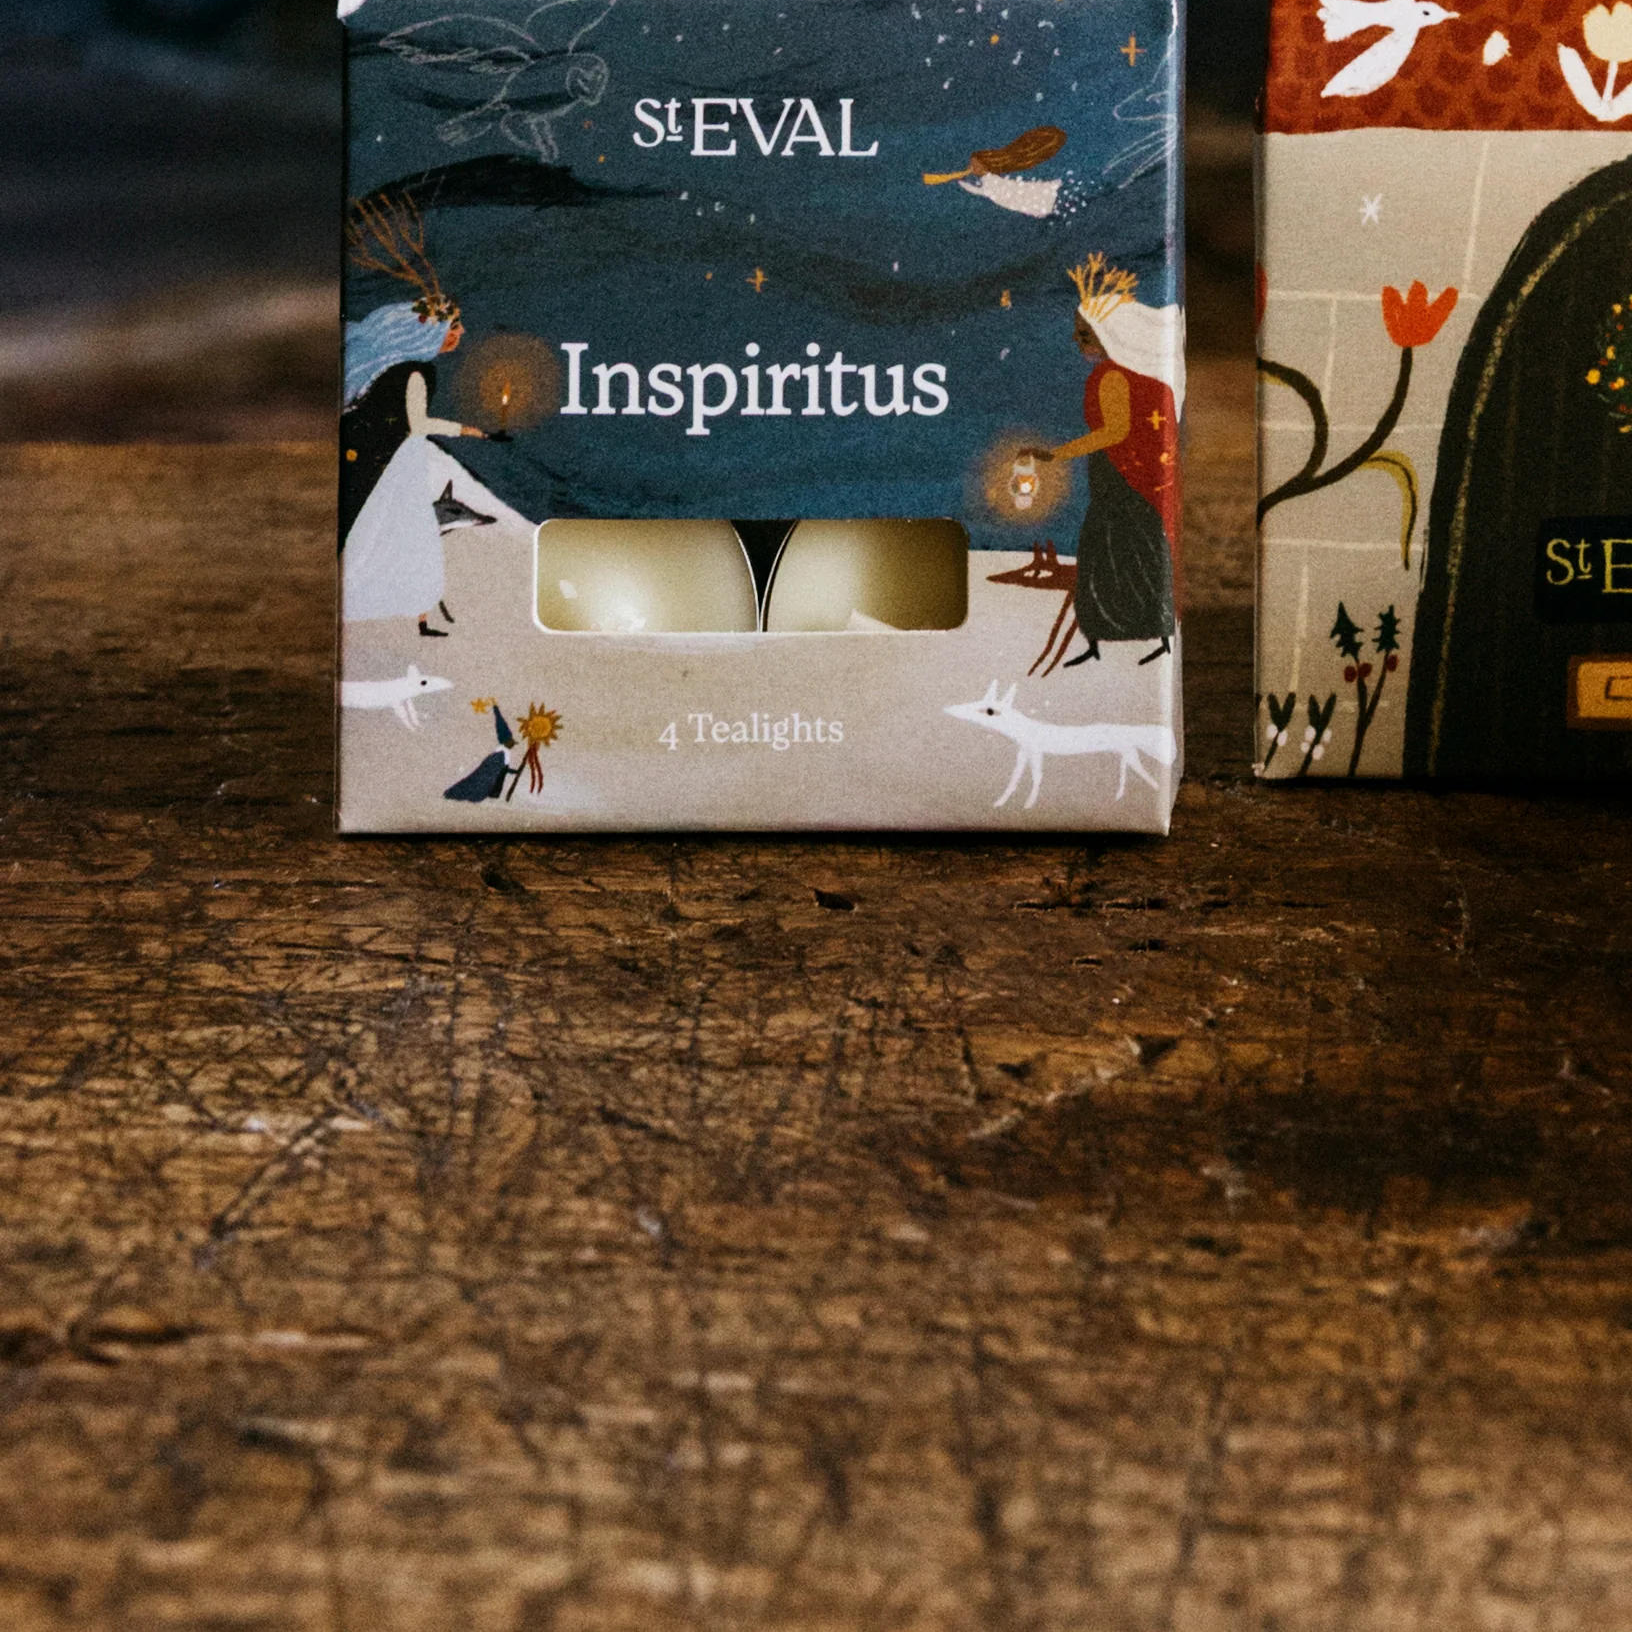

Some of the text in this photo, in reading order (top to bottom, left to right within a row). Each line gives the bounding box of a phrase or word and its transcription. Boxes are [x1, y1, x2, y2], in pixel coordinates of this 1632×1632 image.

[691, 97, 879, 157] EVAL
[560, 342, 949, 436] Inspiritus
[657, 711, 845, 751] 4 Tealights
